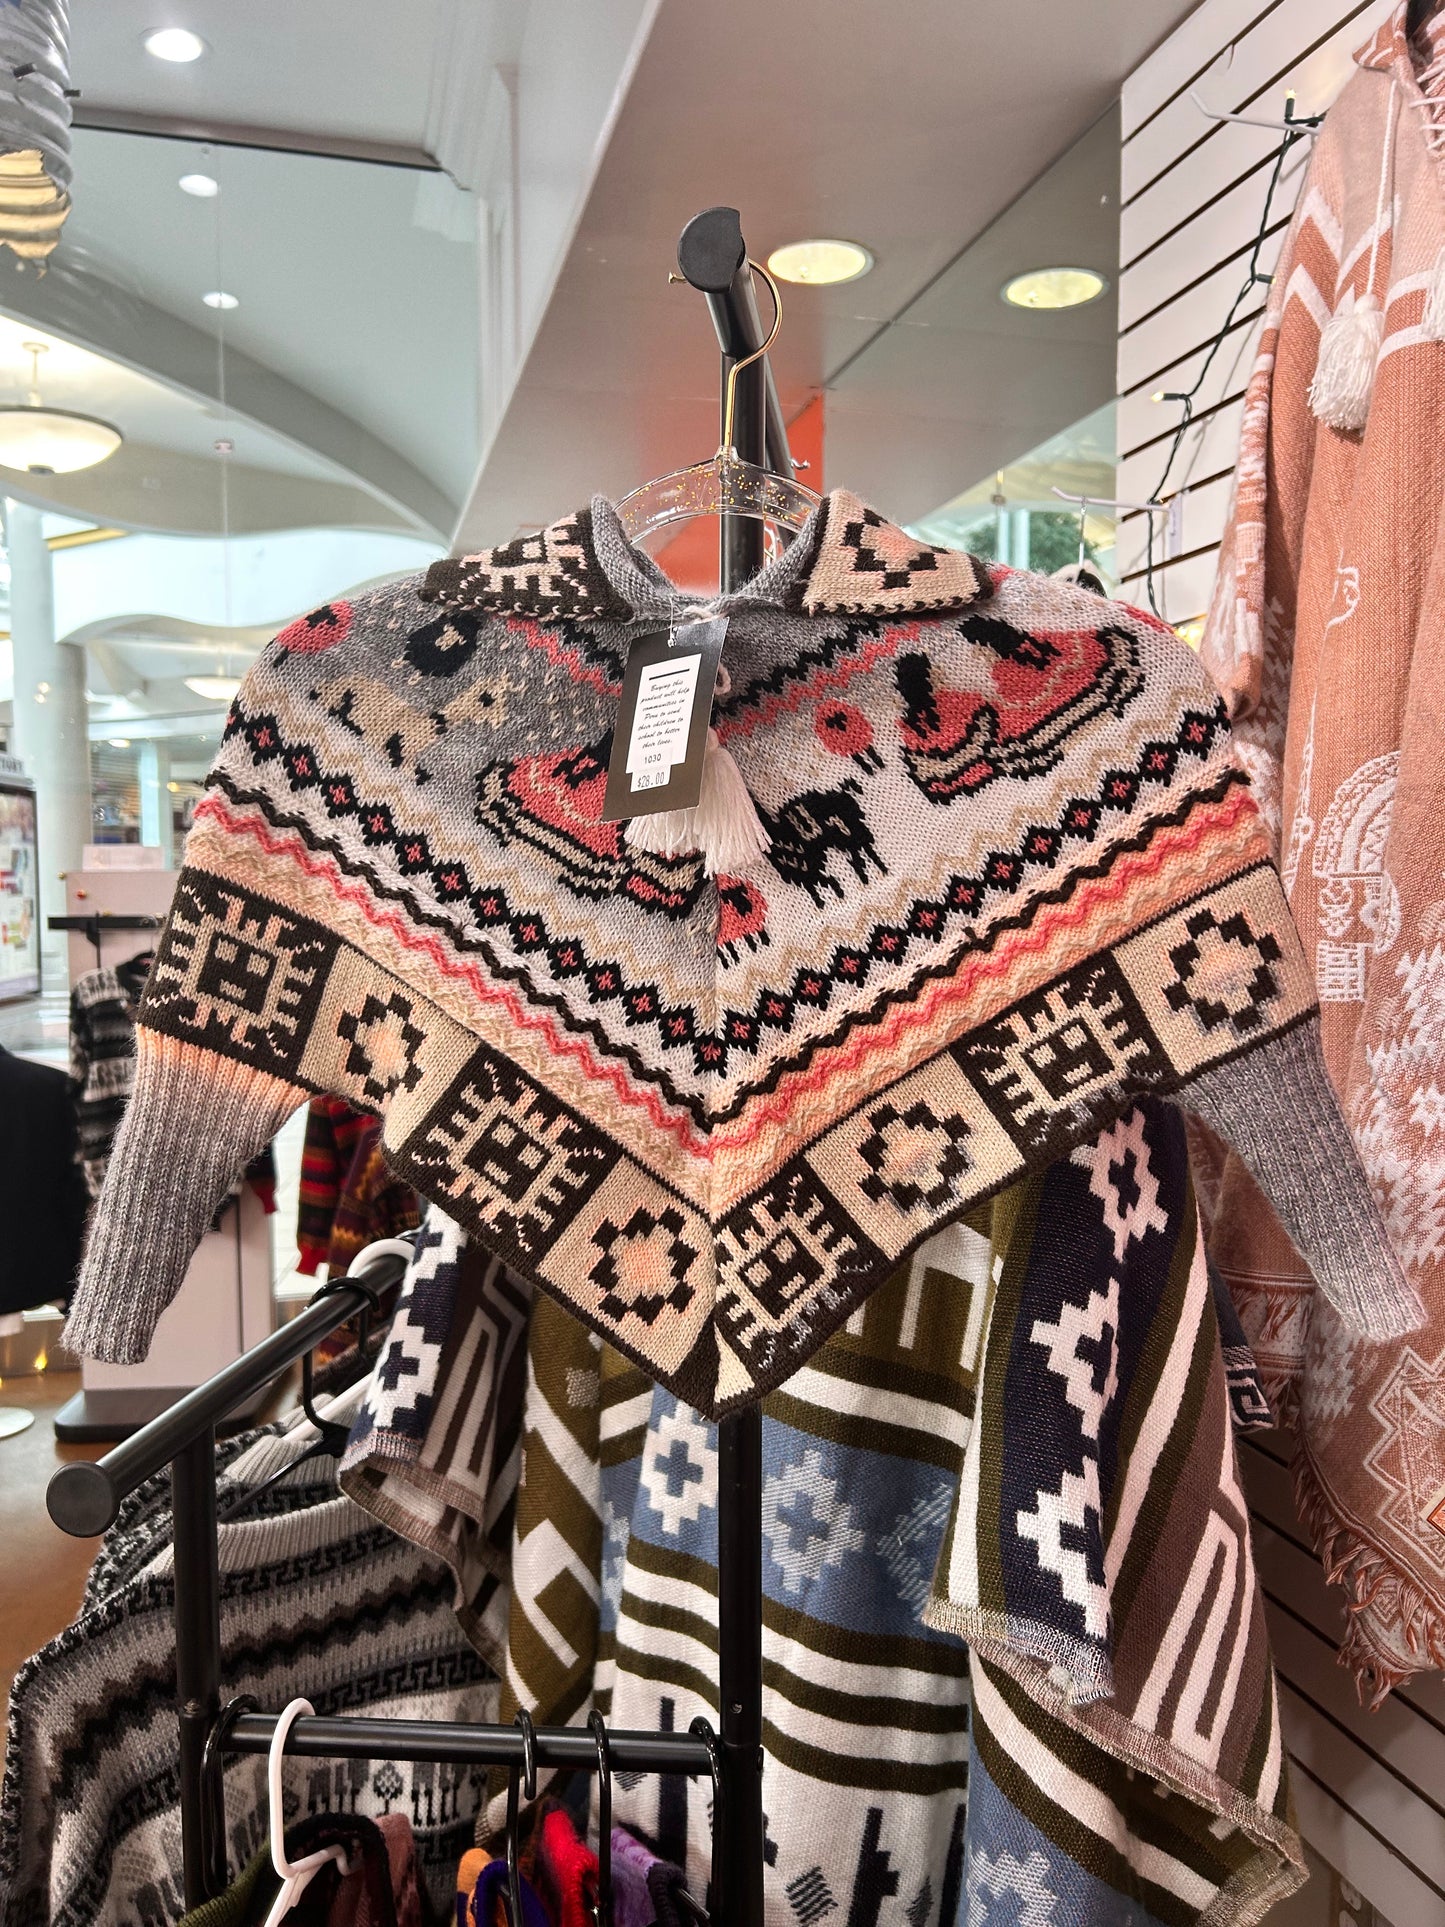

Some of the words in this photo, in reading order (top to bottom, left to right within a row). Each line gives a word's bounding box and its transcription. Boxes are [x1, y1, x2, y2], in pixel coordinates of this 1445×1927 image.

[641, 694, 662, 704] product
[642, 701, 677, 711] communities
[644, 712, 658, 720] Peru
[667, 707, 682, 715] send
[638, 723, 651, 731] their
[652, 719, 676, 728] children
[638, 731, 656, 740] school
[642, 741, 656, 749] their
[644, 753, 662, 764] 1030
[637, 772, 664, 787] $28.00
